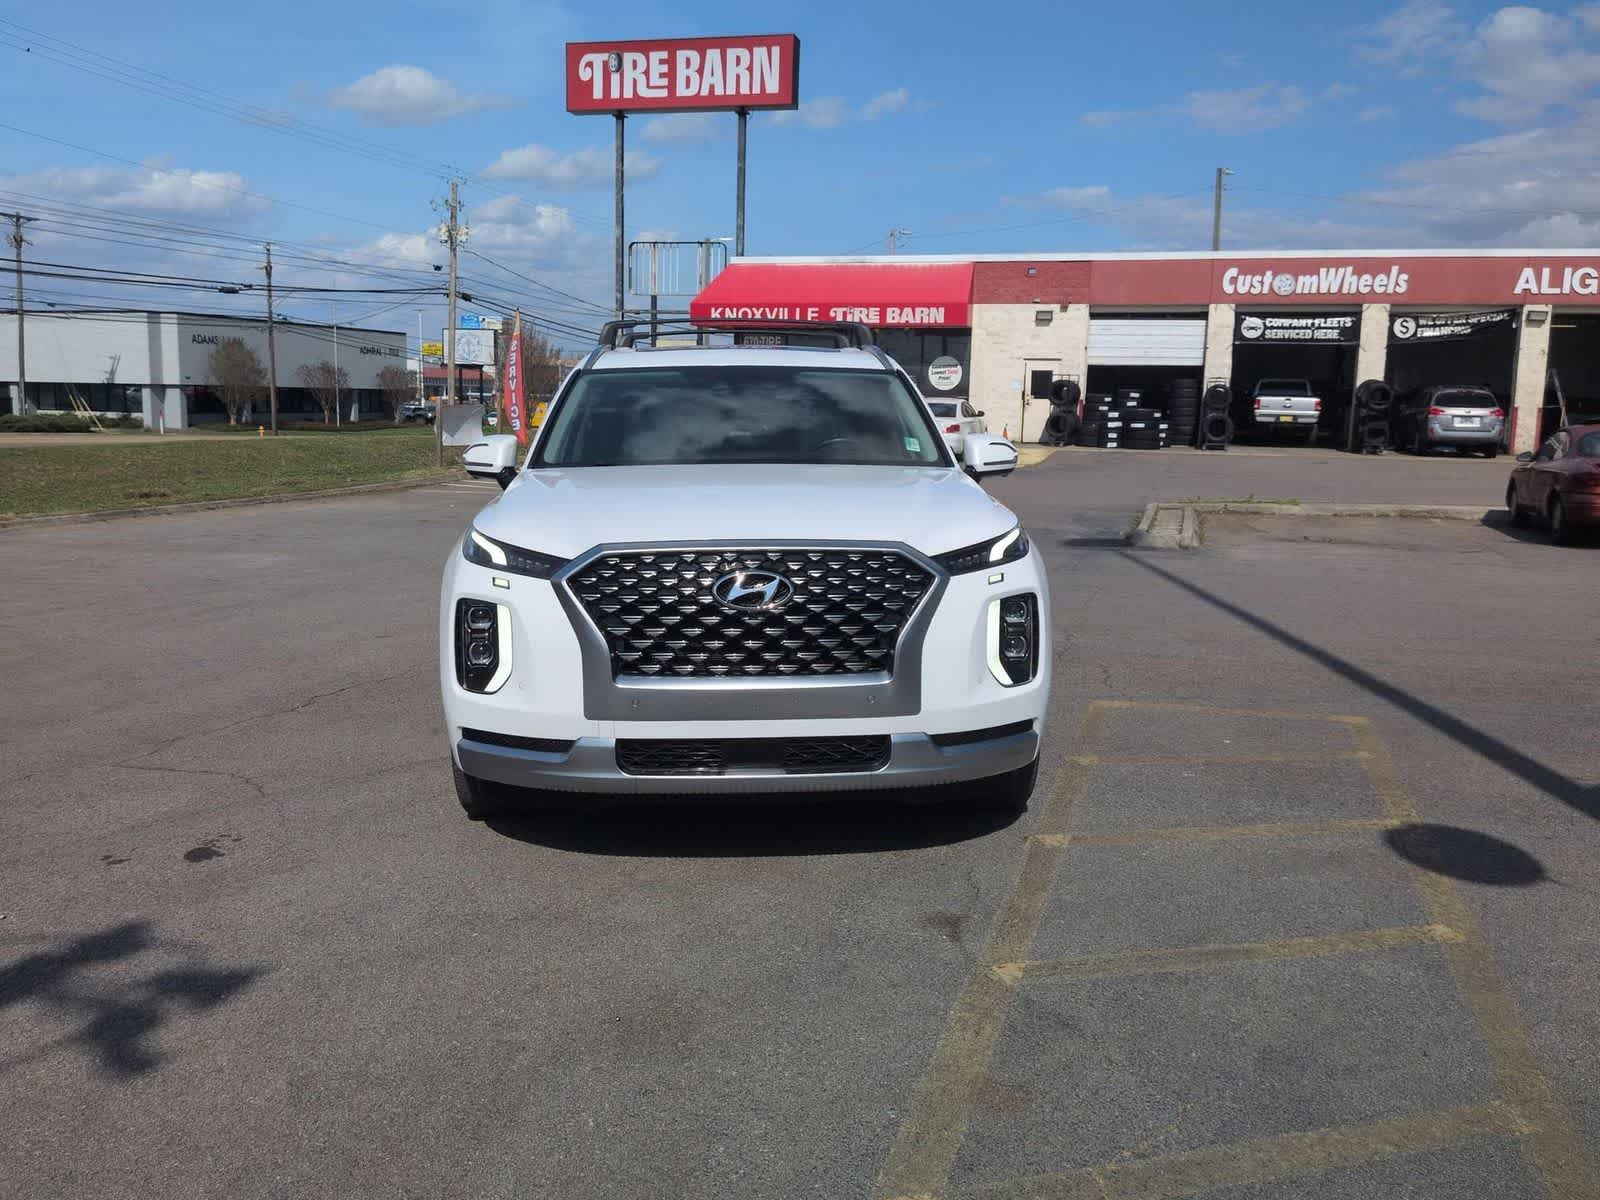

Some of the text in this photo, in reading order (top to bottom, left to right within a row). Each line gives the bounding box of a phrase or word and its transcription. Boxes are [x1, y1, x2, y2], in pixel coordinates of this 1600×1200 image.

[676, 46, 780, 97] BARN
[710, 307, 820, 321] KNOXVILLE
[886, 307, 944, 323] BARN
[1265, 316, 1353, 328] COMPANY FLEETS
[192, 333, 219, 345] ADAMS
[1264, 329, 1341, 340] SERVICED HERE
